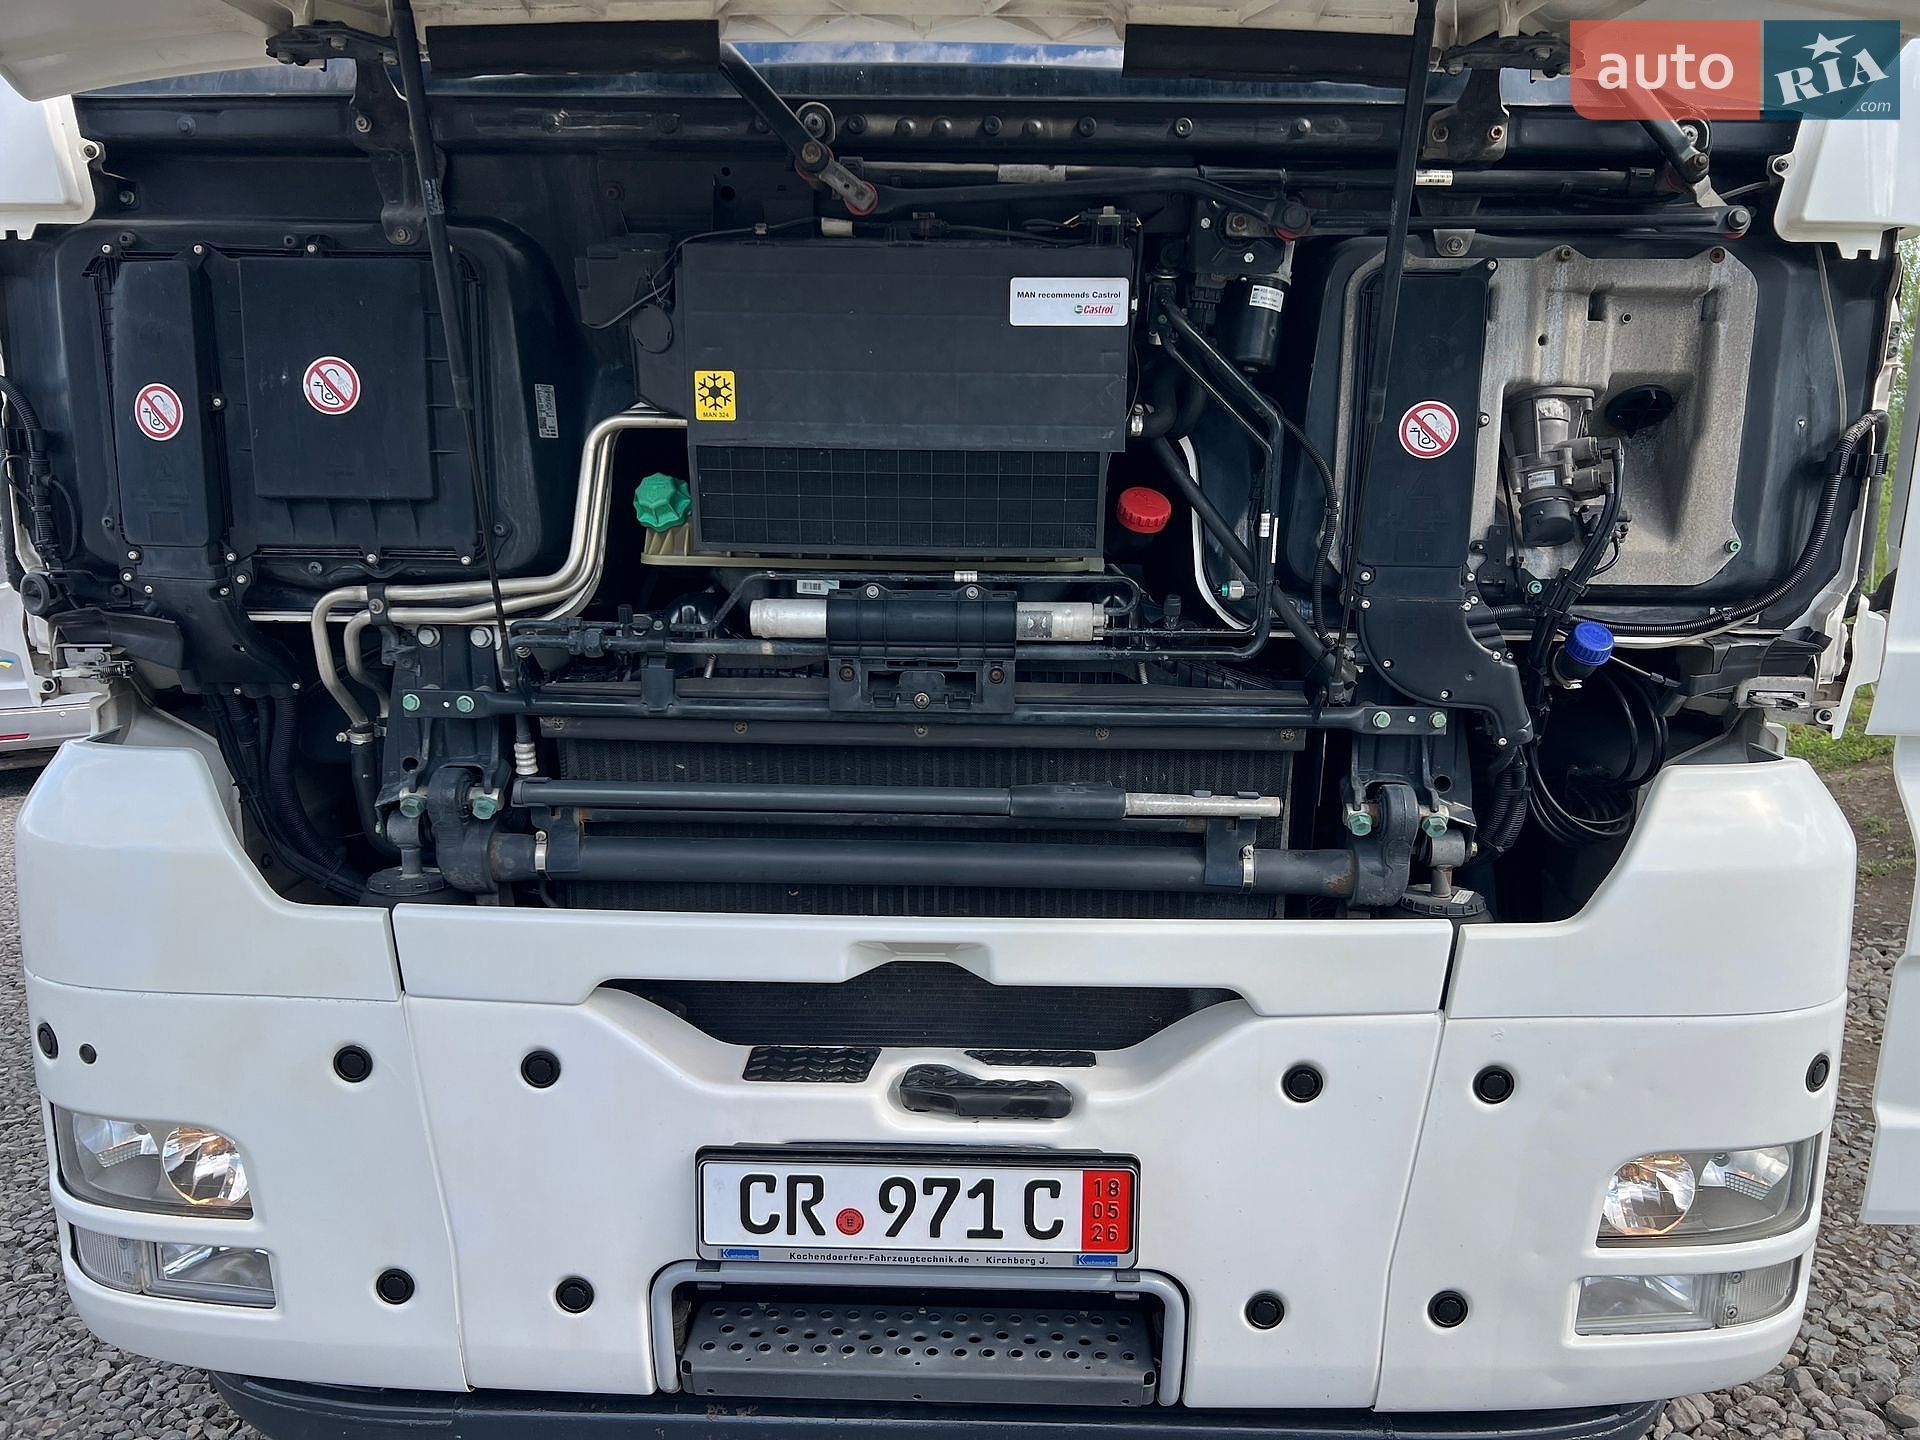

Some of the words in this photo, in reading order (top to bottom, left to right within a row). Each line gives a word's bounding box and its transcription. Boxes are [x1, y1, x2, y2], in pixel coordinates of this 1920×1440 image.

[1017, 291, 1036, 299] MAN
[1038, 291, 1090, 299] recommends
[1092, 291, 1121, 299] Castrol
[1083, 305, 1114, 315] Castrol
[1094, 1178, 1120, 1197] 18
[740, 1174, 826, 1235] CR
[879, 1176, 1004, 1240] 971
[1024, 1179, 1064, 1240] C
[1092, 1202, 1119, 1219] 05
[1091, 1224, 1120, 1242] 26
[789, 1252, 970, 1265] Kochendoerfer-Fahrzeugtechnik.de
[986, 1256, 1036, 1266] Kirchberg
[1039, 1257, 1049, 1265] J.
